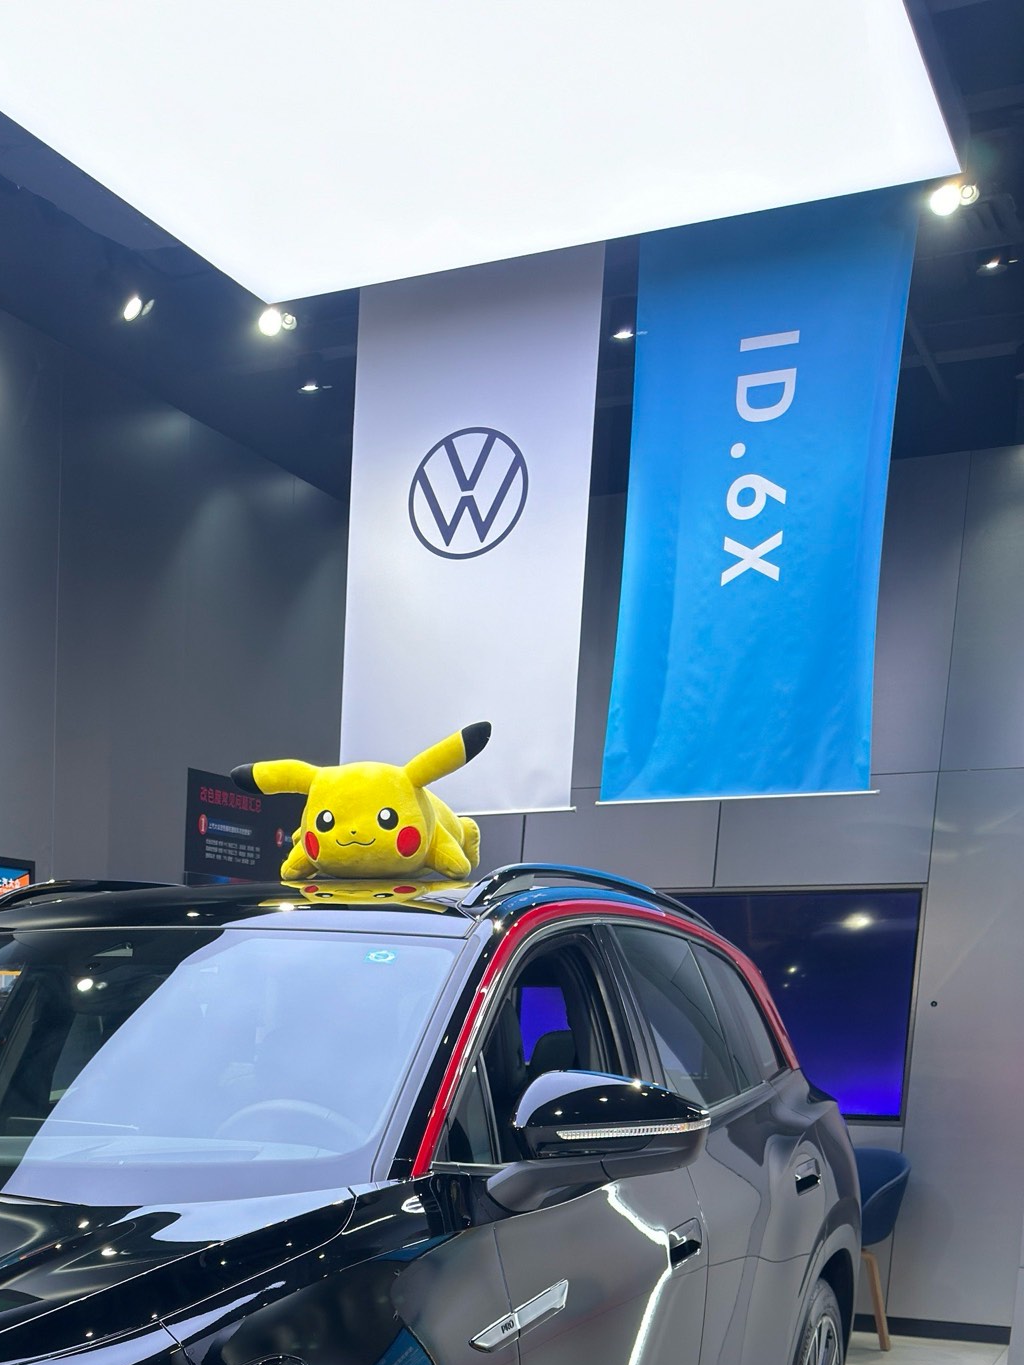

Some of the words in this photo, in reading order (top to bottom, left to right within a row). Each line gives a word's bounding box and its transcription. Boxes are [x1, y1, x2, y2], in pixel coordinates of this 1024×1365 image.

[409, 427, 529, 560] VW
[721, 329, 801, 587] ID.6X
[500, 1319, 515, 1334] PRO
